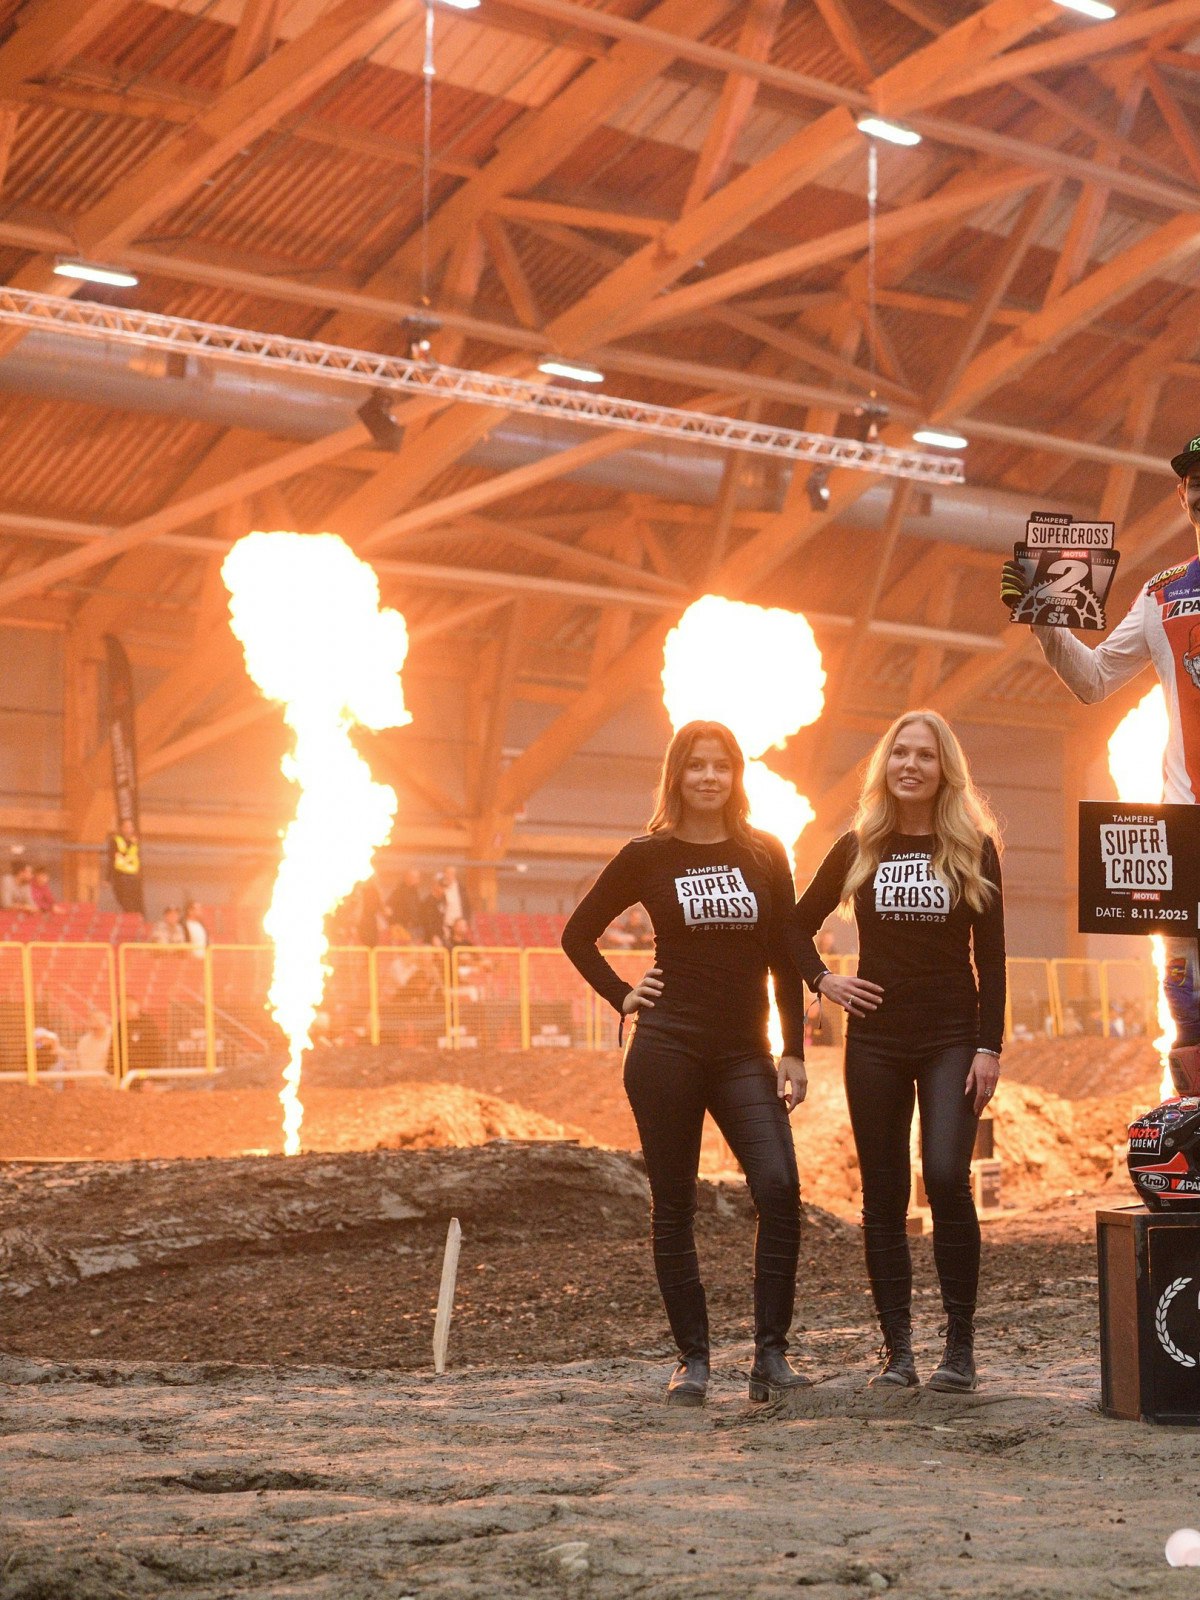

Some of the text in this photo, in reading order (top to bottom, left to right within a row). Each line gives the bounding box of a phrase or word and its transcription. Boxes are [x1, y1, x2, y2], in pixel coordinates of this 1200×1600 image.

[1035, 515, 1068, 525] TAMPERE
[1031, 527, 1109, 545] SUPERCROSS
[1036, 559, 1089, 599] 2
[1044, 596, 1078, 607] SECOND
[1047, 612, 1069, 625] SX
[1112, 815, 1154, 824] TAMPERE
[891, 852, 932, 860] TAMPERE
[686, 864, 729, 875] TAMPERE
[1112, 859, 1167, 886] CROSS
[881, 885, 944, 908] CROSS
[1133, 892, 1160, 900] MOTUL
[690, 897, 753, 920] CROSS
[1096, 907, 1188, 920] DATE: 8.11.2025
[881, 913, 946, 923] 7.-8.11.2025
[1141, 1175, 1165, 1188] Arai
